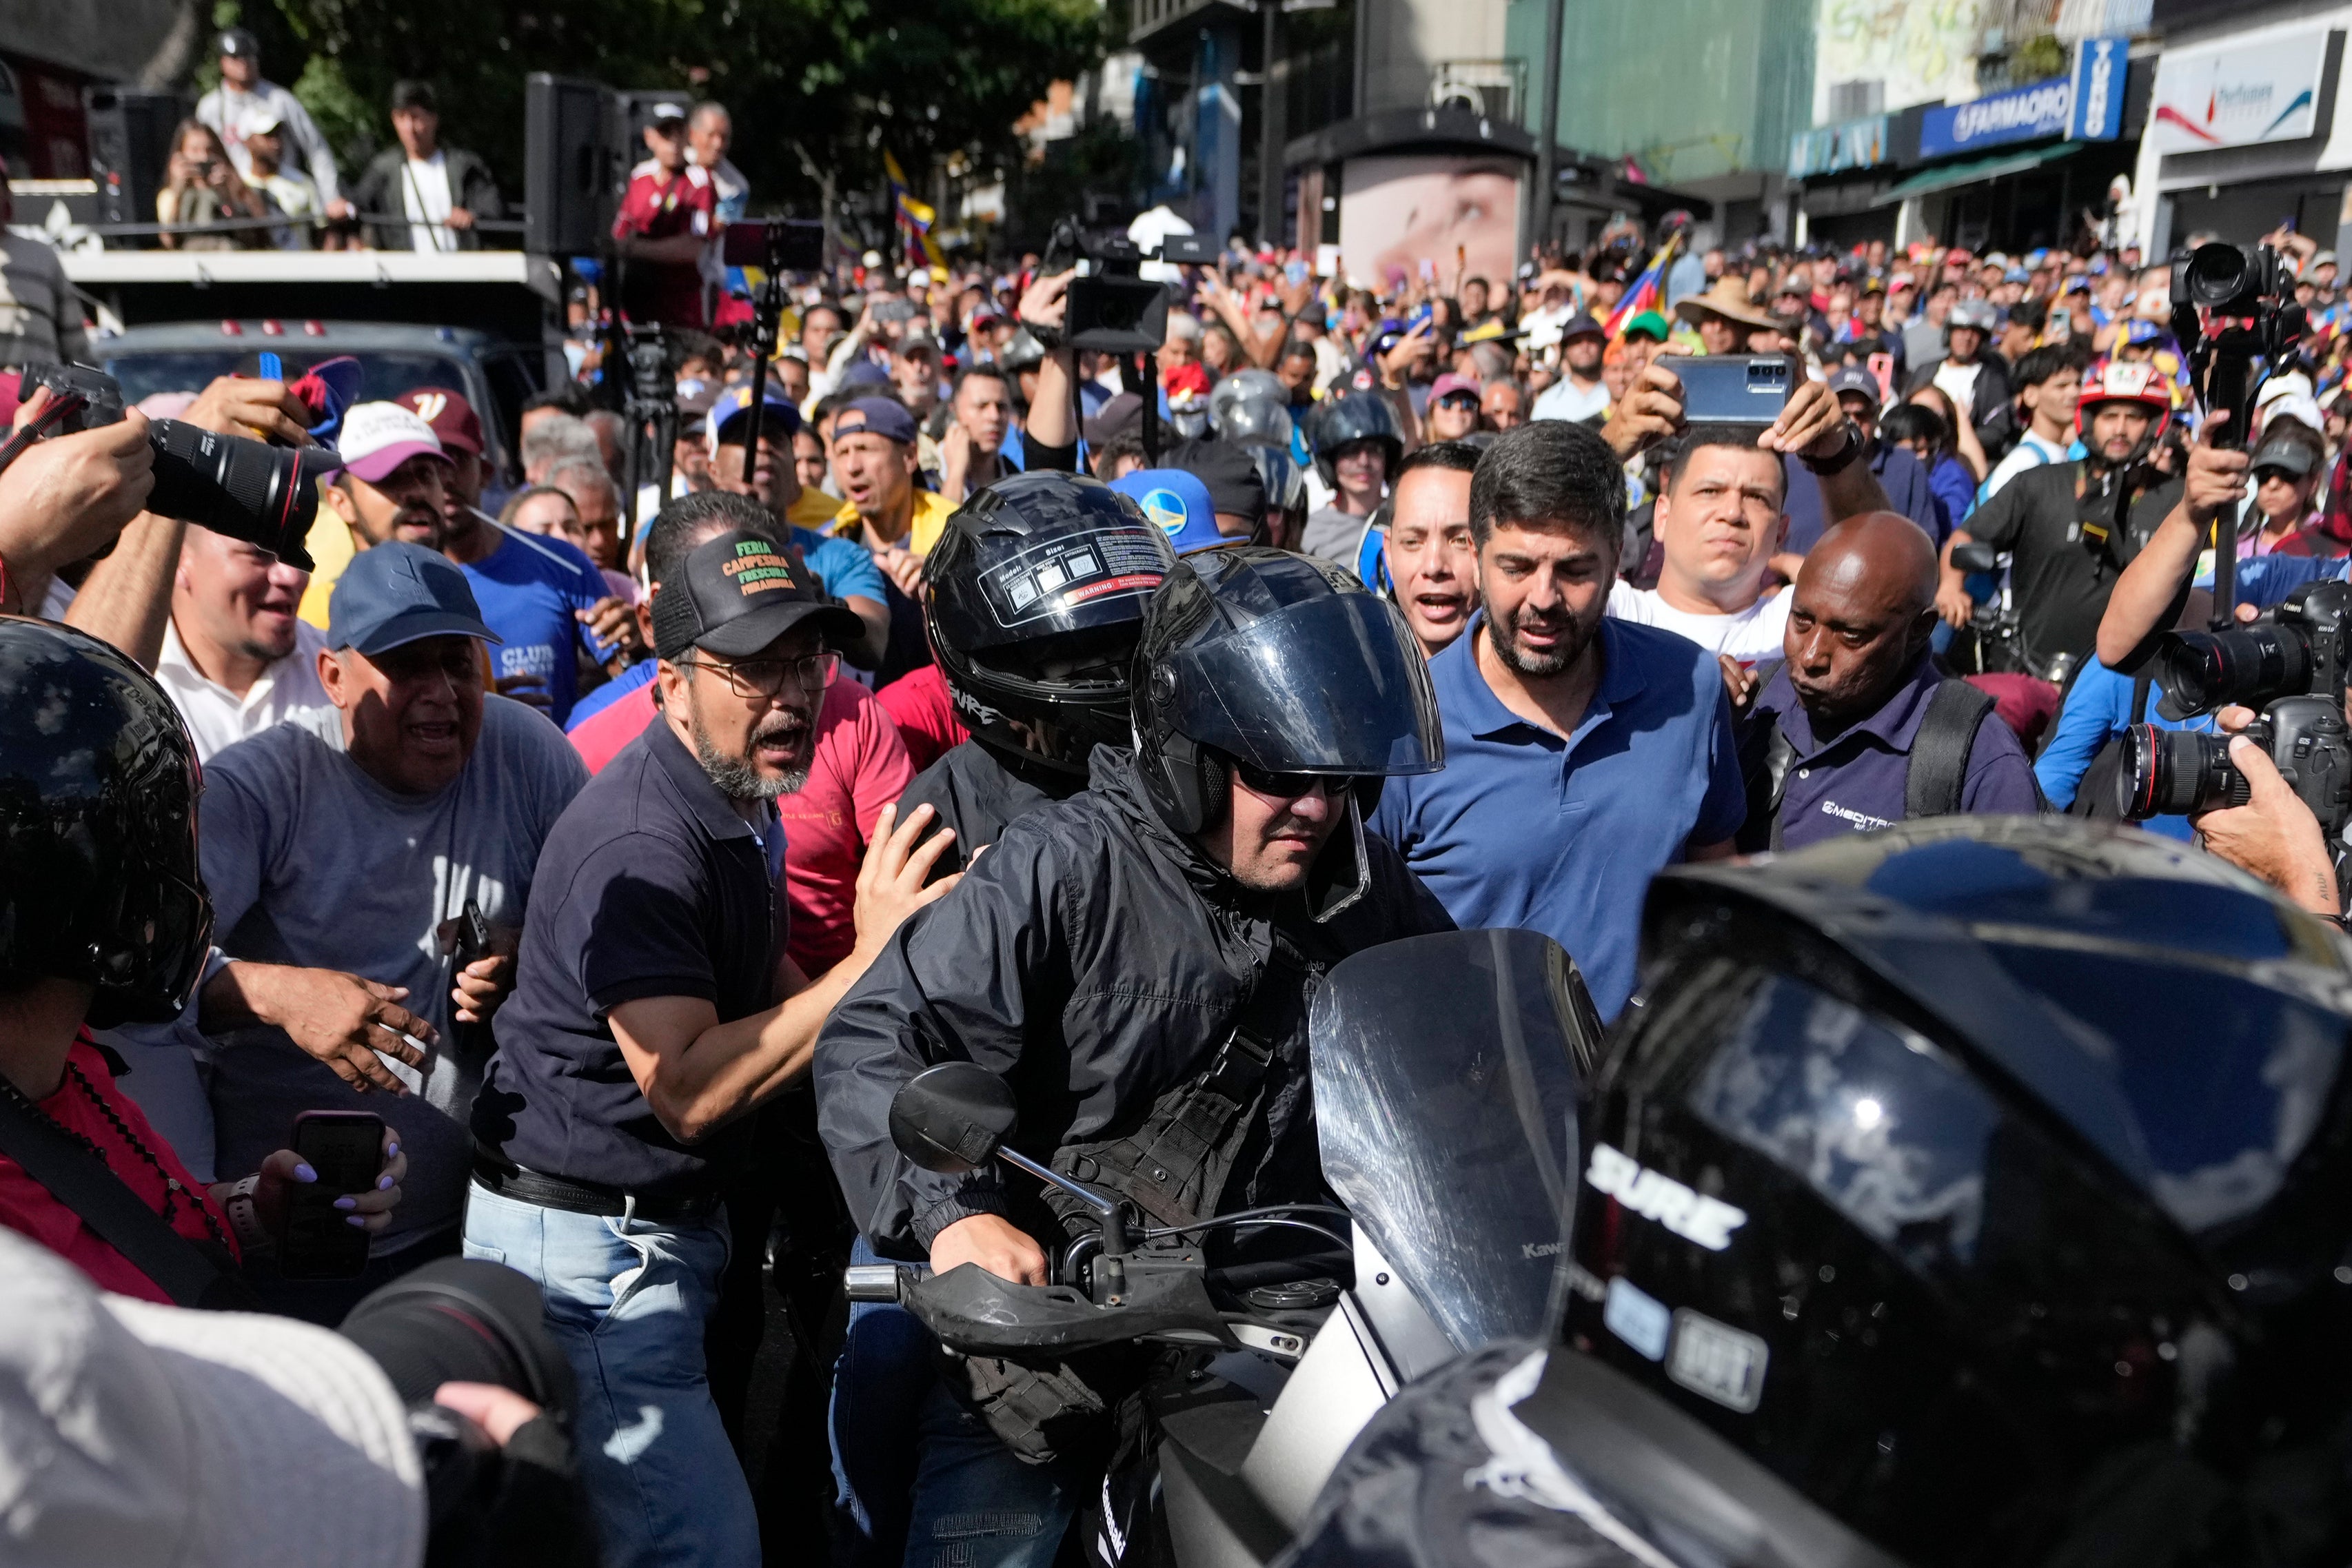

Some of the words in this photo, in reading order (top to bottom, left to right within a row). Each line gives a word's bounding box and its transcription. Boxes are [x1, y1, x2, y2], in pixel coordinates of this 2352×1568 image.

[2085, 39, 2113, 137] TURNO
[736, 541, 772, 557] FERIA
[1064, 547, 1088, 558] ANTISCRATCH
[722, 554, 790, 577] CAMPESINA
[1000, 565, 1022, 583] Model:
[1045, 544, 1065, 556] Size:
[738, 567, 789, 584] FRESCURA
[1078, 582, 1115, 598] WARNING!
[2298, 737, 2311, 746] EOS
[1102, 1474, 1126, 1560] Kawasaki
